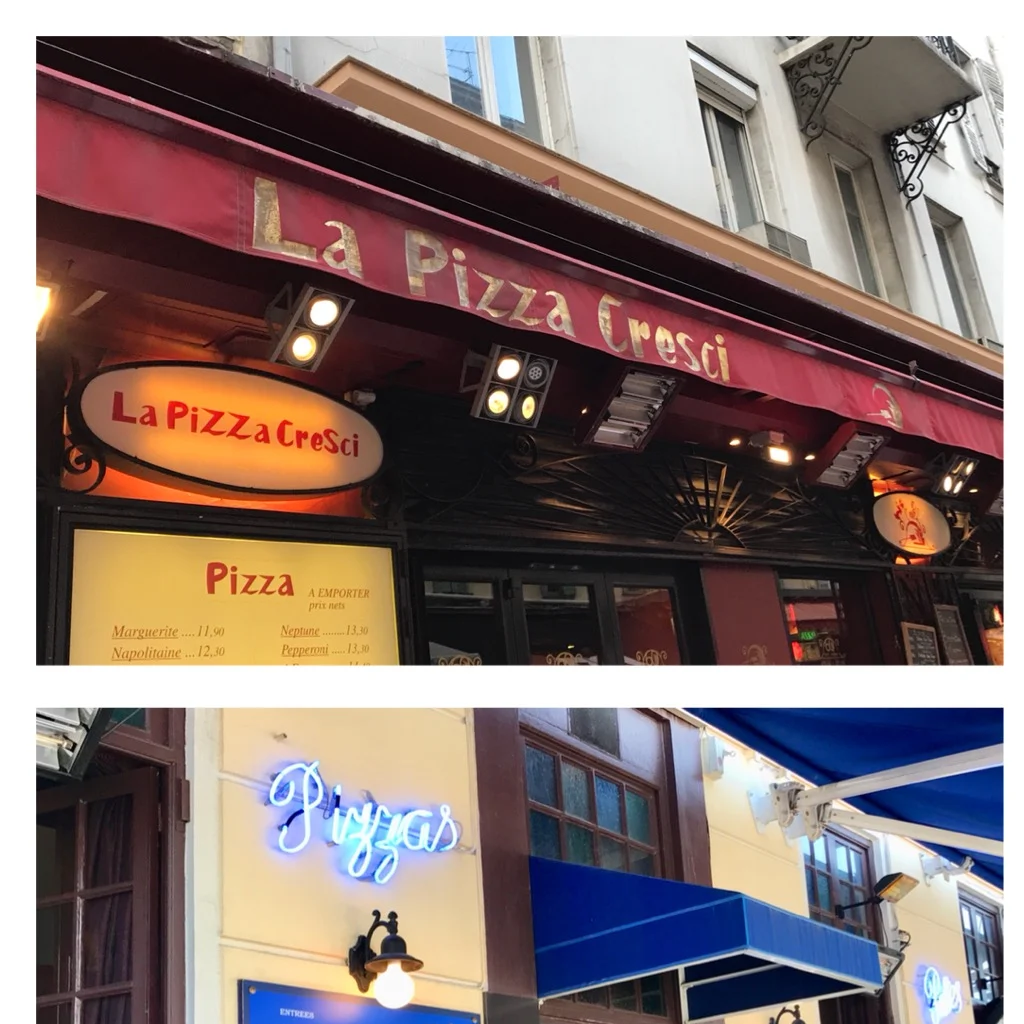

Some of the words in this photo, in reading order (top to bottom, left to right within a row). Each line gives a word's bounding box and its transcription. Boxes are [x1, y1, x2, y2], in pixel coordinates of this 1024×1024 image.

[252, 177, 363, 279] La
[405, 228, 576, 338] Pizza
[597, 294, 729, 384] Cresci
[112, 391, 158, 427] La
[207, 561, 295, 597] Pizza
[318, 587, 370, 600] EMPORTER
[308, 600, 326, 612] prix
[328, 600, 346, 611] nets
[112, 625, 179, 640] Marguerite
[281, 625, 320, 638] Neptune
[111, 646, 182, 662] Napolitaine
[281, 643, 329, 657] Pepperoni
[269, 761, 458, 885] Pizzas
[280, 1008, 314, 1019] ENTREES
